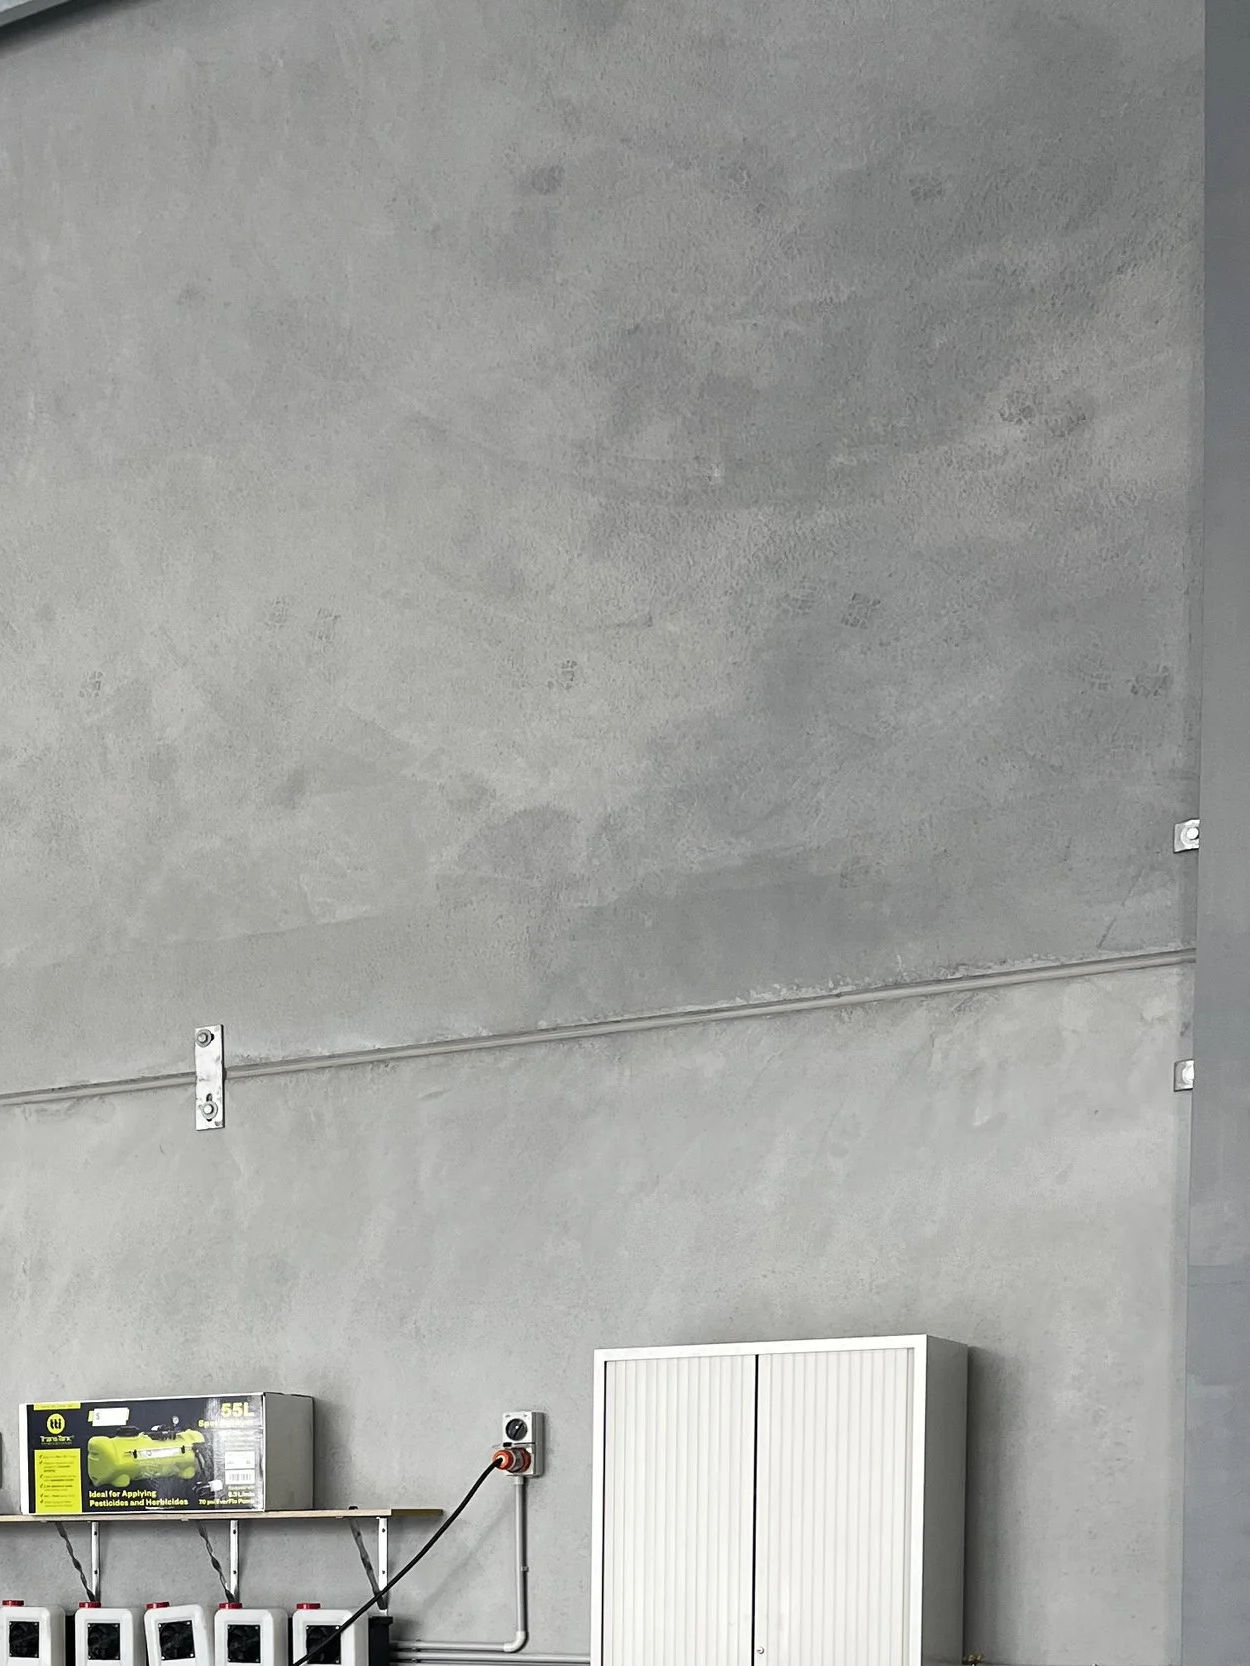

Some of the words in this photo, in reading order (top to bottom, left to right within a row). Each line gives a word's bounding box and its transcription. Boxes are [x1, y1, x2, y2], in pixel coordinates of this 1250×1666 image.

[220, 1402, 254, 1418] 55L
[89, 1490, 108, 1498] Ideal
[109, 1490, 120, 1498] for
[122, 1489, 157, 1499] Applying
[89, 1499, 129, 1507] Pesticides
[130, 1498, 145, 1507] and
[145, 1497, 188, 1506] Herbicides
